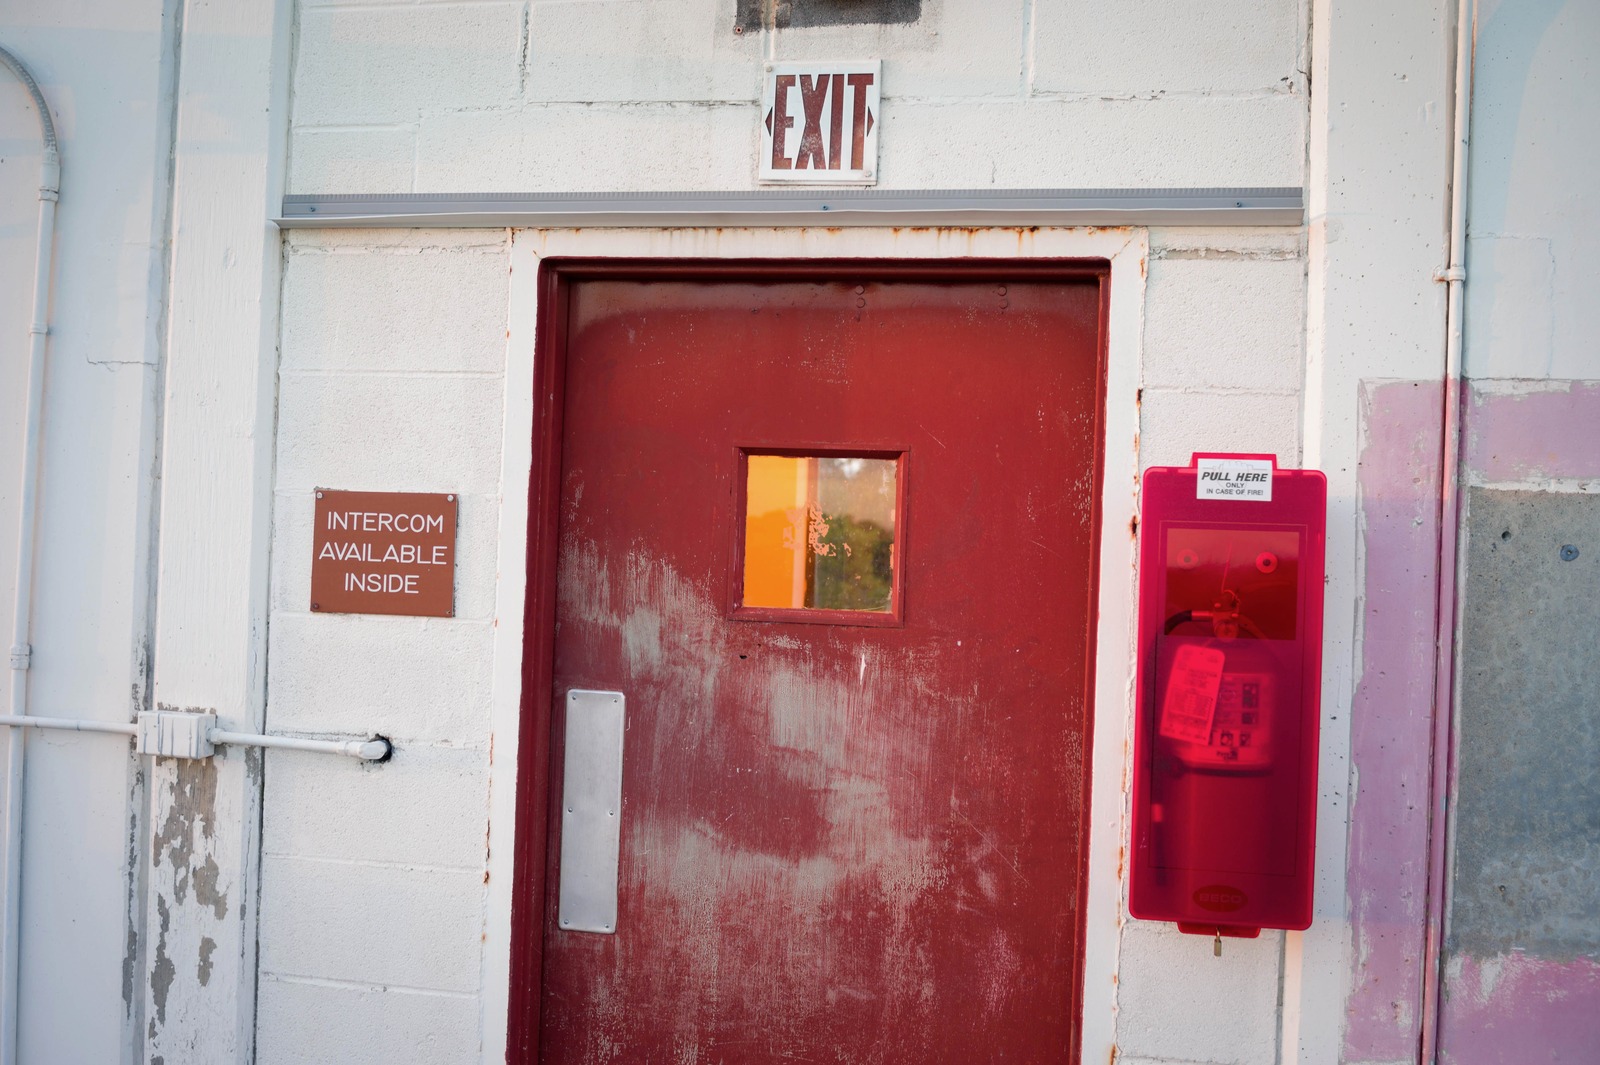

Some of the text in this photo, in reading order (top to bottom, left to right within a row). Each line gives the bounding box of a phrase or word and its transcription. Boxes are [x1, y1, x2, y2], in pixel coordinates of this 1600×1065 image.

[771, 73, 874, 170] EXIT
[1201, 471, 1268, 482] PULL HERE
[327, 511, 444, 533] INTERCOM
[318, 541, 448, 565] AVAILABLE
[344, 572, 420, 594] INSIDE
[1199, 893, 1242, 904] BECO
